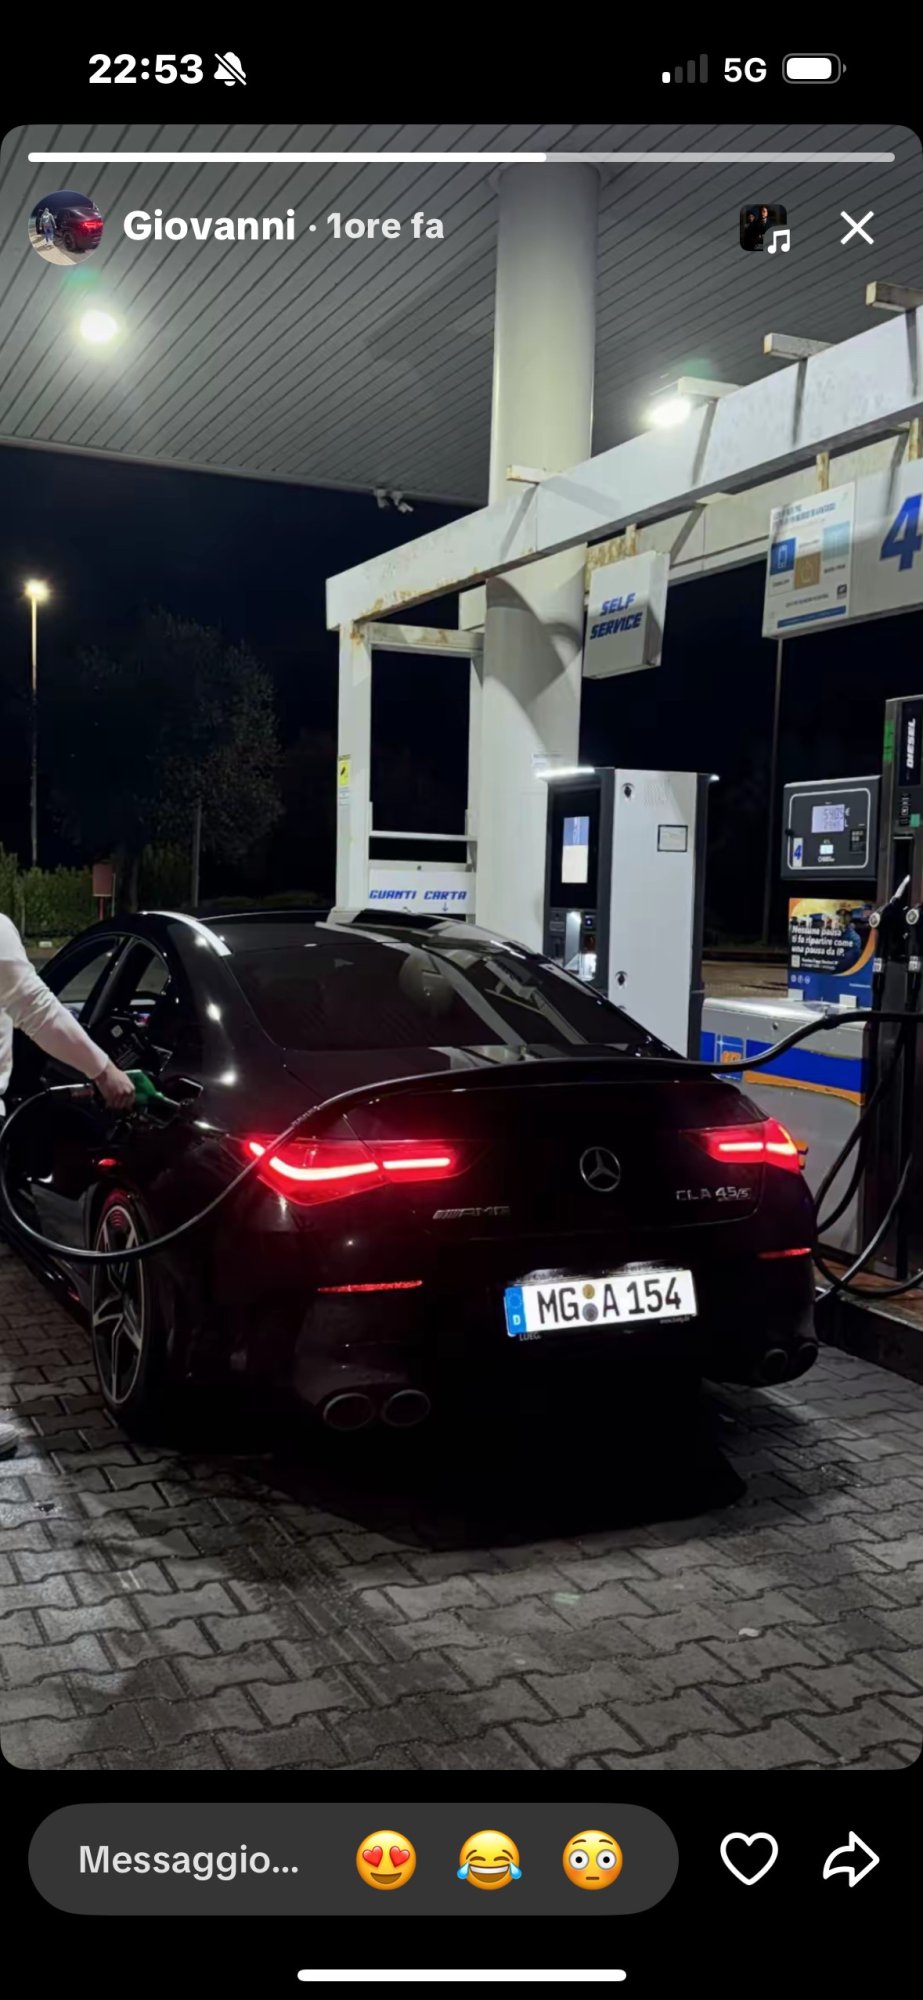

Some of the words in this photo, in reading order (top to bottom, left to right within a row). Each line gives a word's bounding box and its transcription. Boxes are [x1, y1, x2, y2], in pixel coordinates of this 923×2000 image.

[880, 493, 923, 573] 4
[600, 592, 636, 616] SELF
[590, 611, 643, 640] SERVICE
[906, 717, 916, 769] DIESEL
[794, 844, 802, 860] 4
[368, 889, 418, 900] GUANTI
[423, 890, 468, 901] CARTA
[804, 946, 826, 956] pausa
[826, 947, 836, 955] da
[833, 940, 854, 948] come
[676, 1188, 712, 1201] CLA
[536, 1286, 580, 1325] MG
[602, 1283, 620, 1318] A
[626, 1277, 682, 1315] 154
